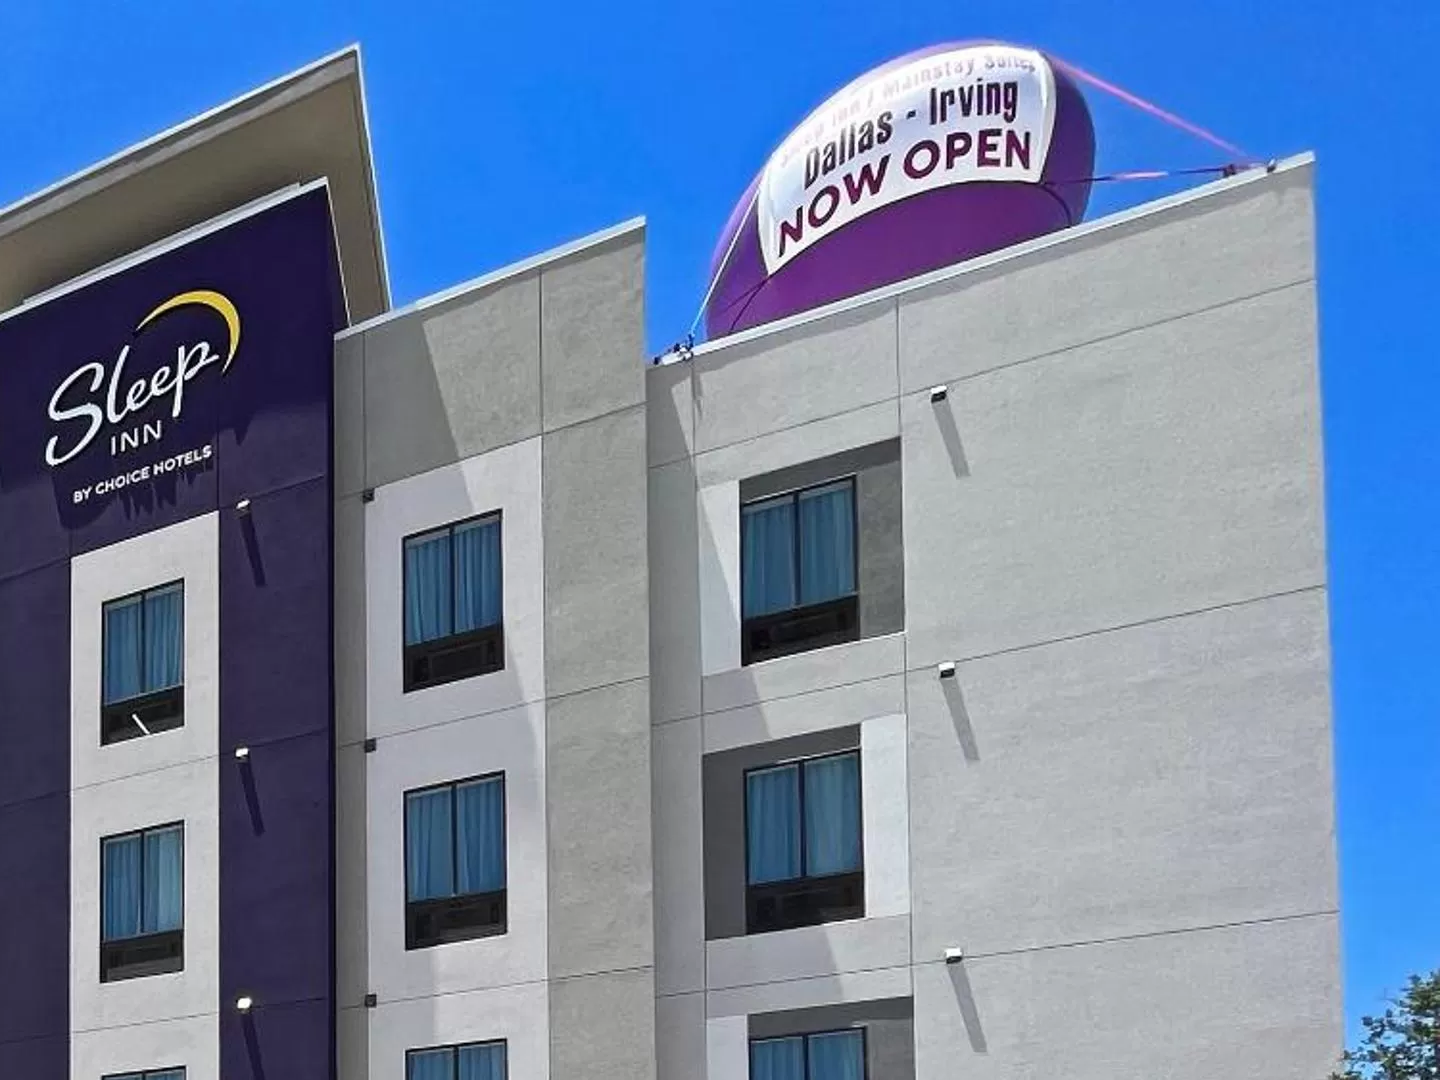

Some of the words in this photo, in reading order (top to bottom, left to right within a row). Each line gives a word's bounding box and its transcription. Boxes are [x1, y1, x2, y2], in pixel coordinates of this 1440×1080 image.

[804, 110, 893, 188] Dallas
[906, 110, 918, 120] -
[929, 77, 1018, 125] Irving
[778, 154, 891, 257] NOW
[903, 128, 1031, 180] OPEN
[45, 341, 220, 467] Sleep
[111, 419, 162, 456] INN
[72, 486, 92, 504] BY
[95, 465, 151, 495] CHOICE
[153, 444, 213, 476] HOTELS
